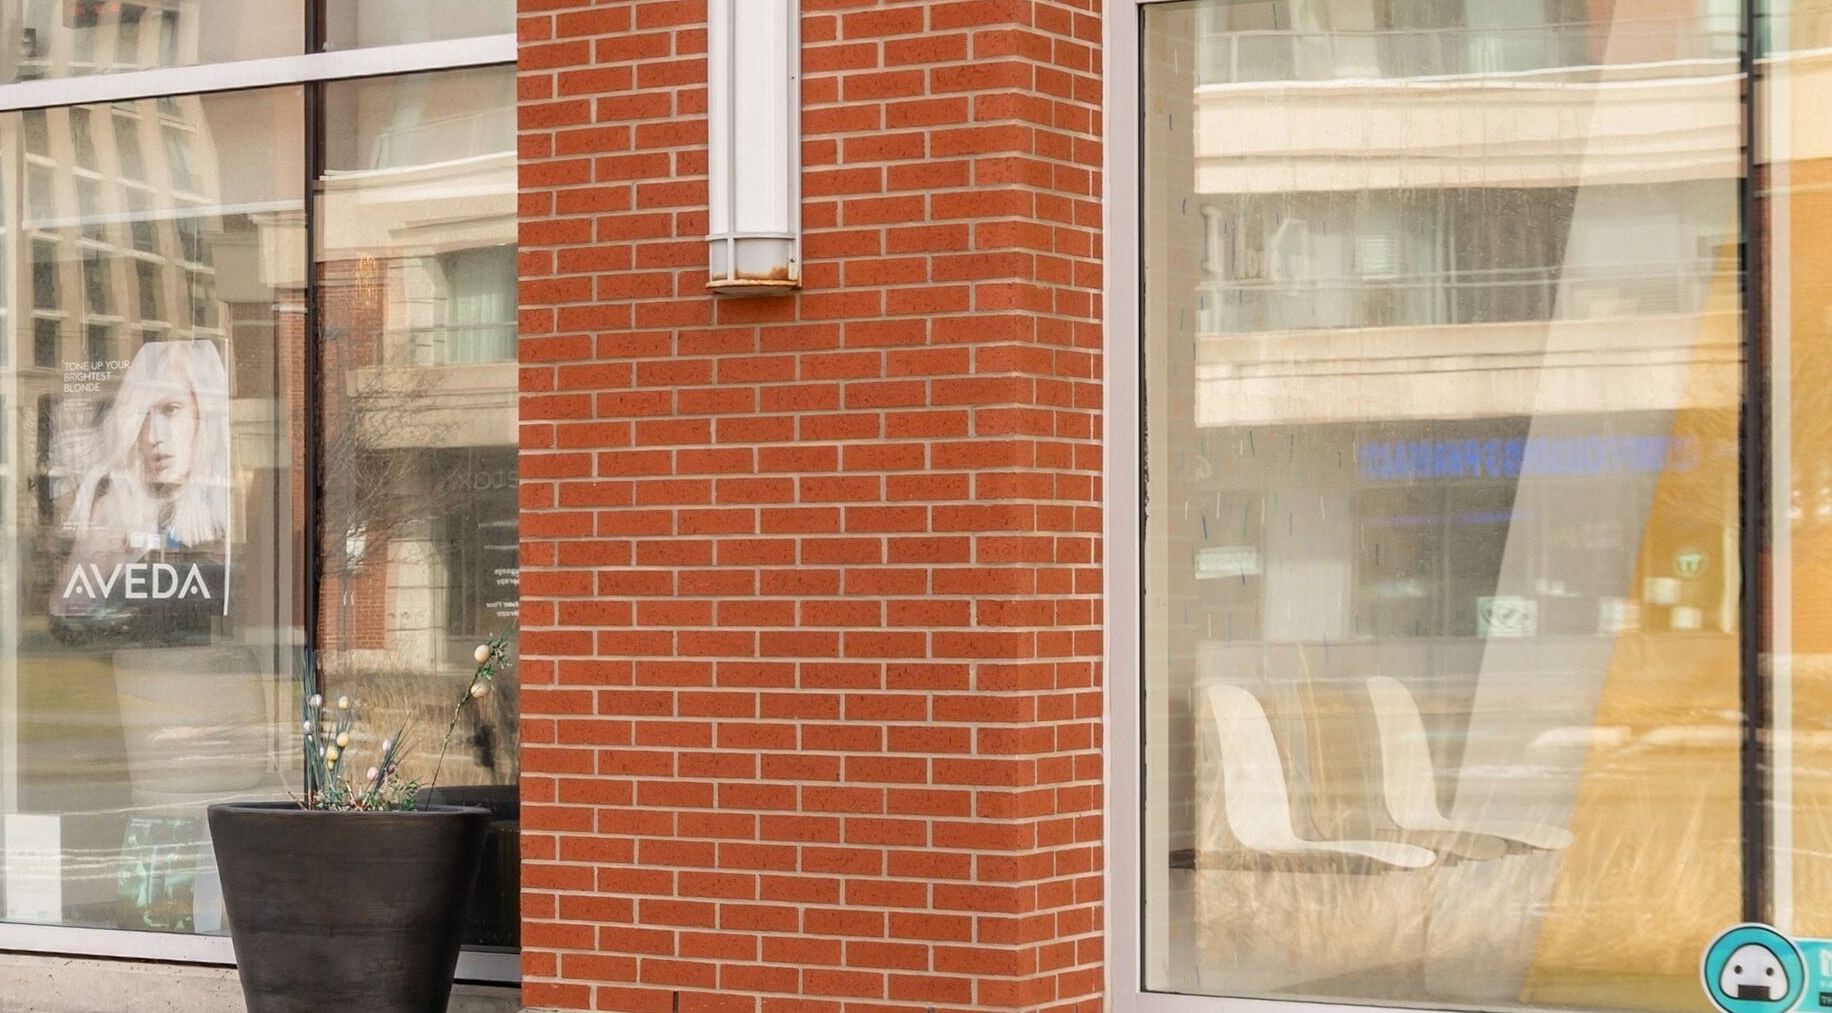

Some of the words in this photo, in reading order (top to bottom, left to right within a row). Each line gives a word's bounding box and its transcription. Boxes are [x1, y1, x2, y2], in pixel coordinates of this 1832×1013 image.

[63, 361, 89, 371] TONE
[91, 361, 103, 370] UP
[105, 360, 130, 369] YOUR
[63, 371, 111, 382] BRIGHTEST
[63, 382, 101, 393] BLONDE
[62, 563, 211, 599] AVEDA
